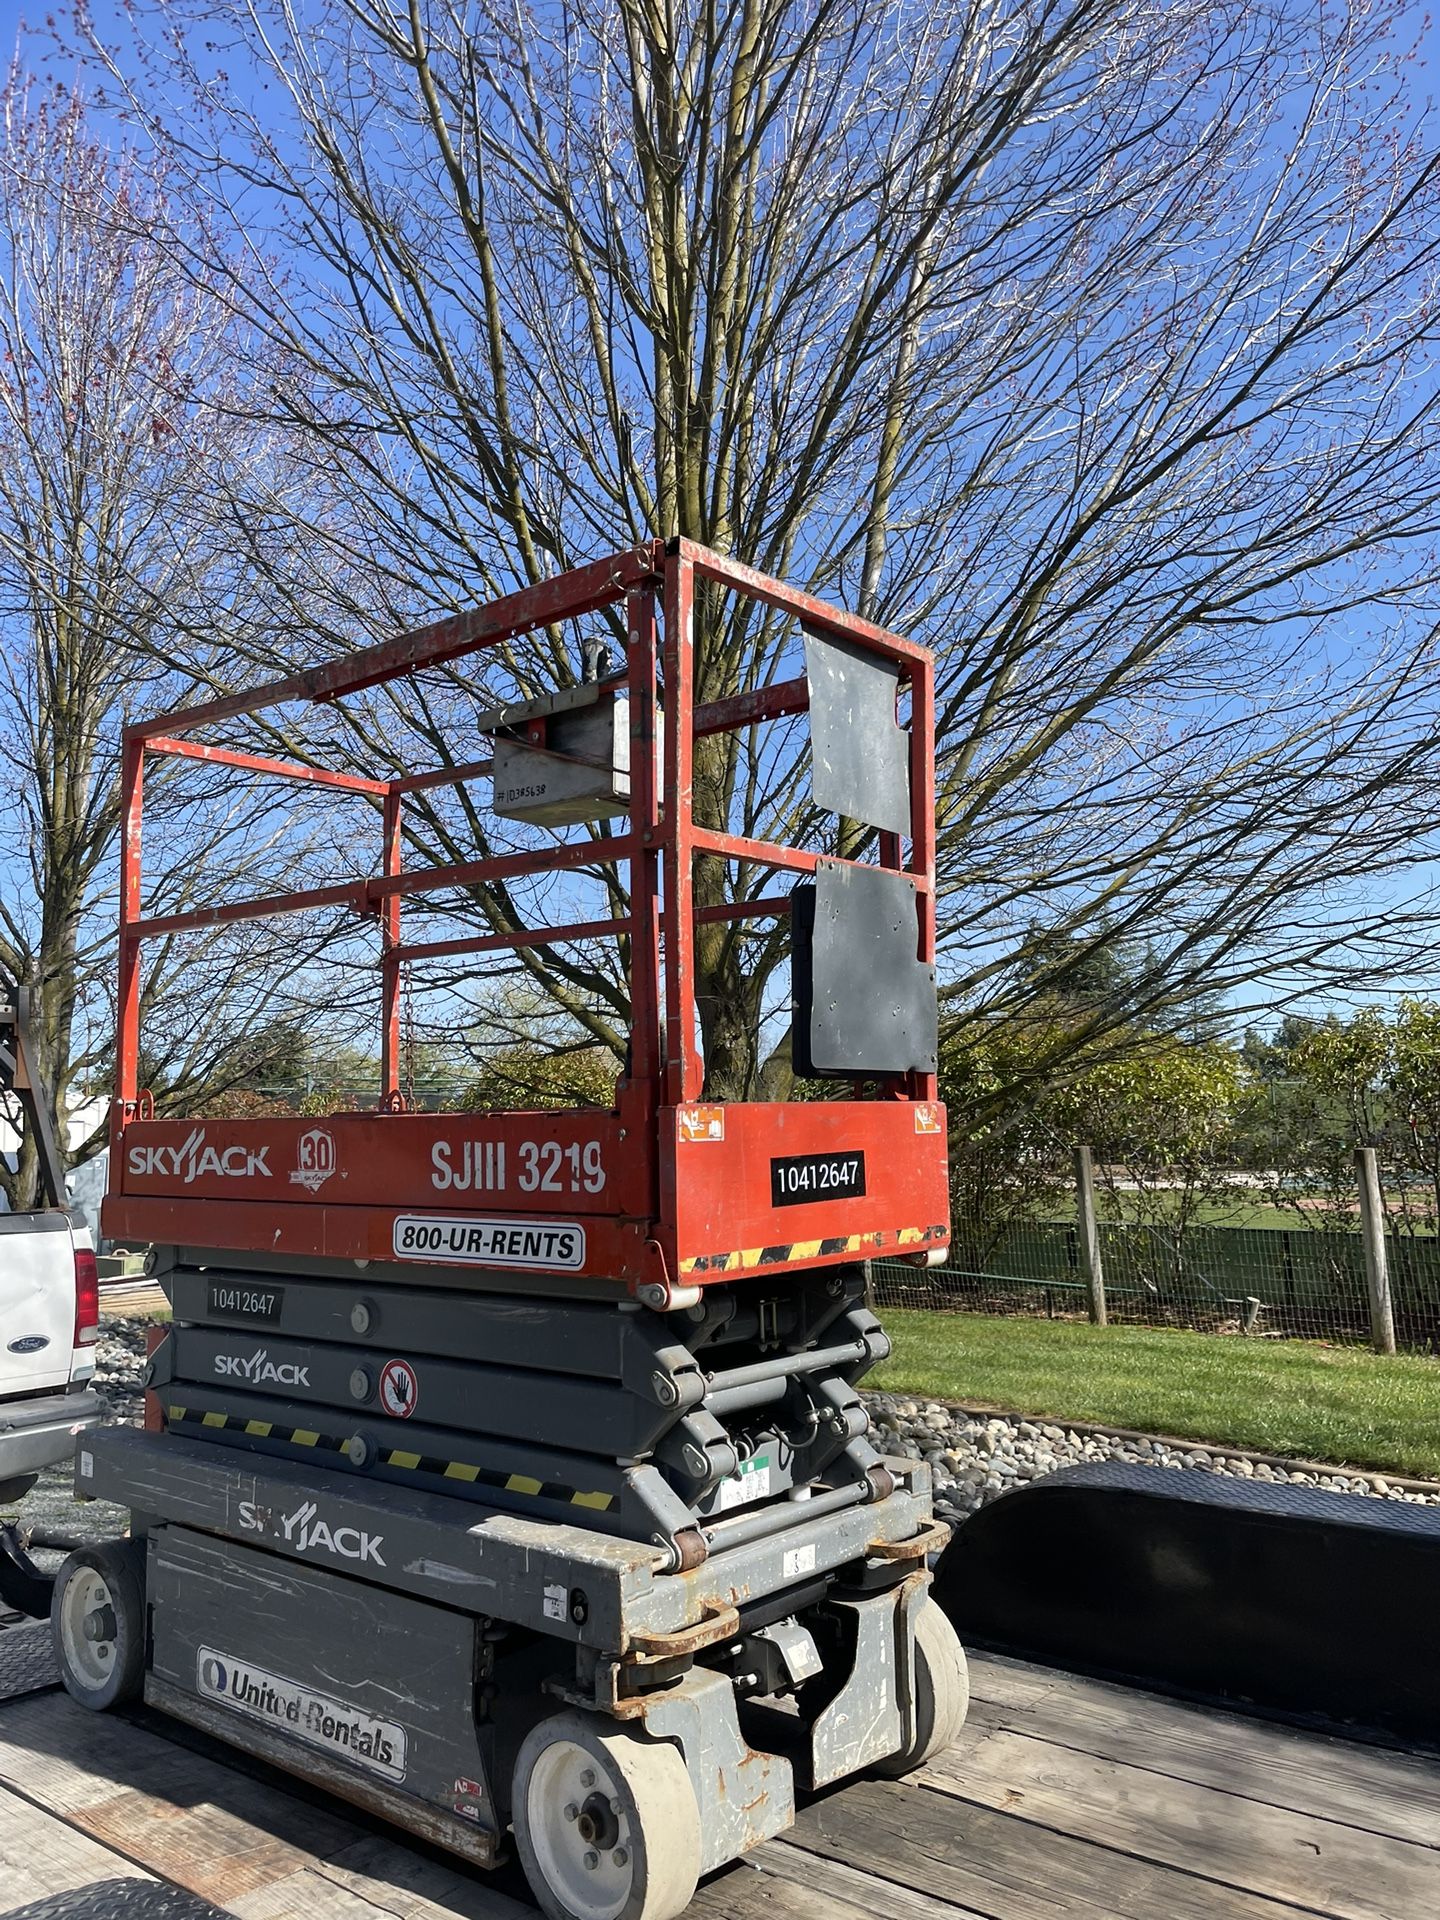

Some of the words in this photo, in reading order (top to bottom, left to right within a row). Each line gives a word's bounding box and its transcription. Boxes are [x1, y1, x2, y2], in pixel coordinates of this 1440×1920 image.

[129, 1128, 273, 1184] SKYJACK
[303, 1136, 330, 1170] 30
[431, 1141, 506, 1190] SJIII
[518, 1141, 606, 1193] 3219
[778, 1161, 858, 1193] 10412647
[402, 1226, 575, 1260] 800-UR-RENTS
[213, 1288, 275, 1315] 10412647
[215, 1348, 311, 1387] SKYJACK
[231, 1670, 301, 1724] United
[302, 1700, 394, 1765] Rentals
